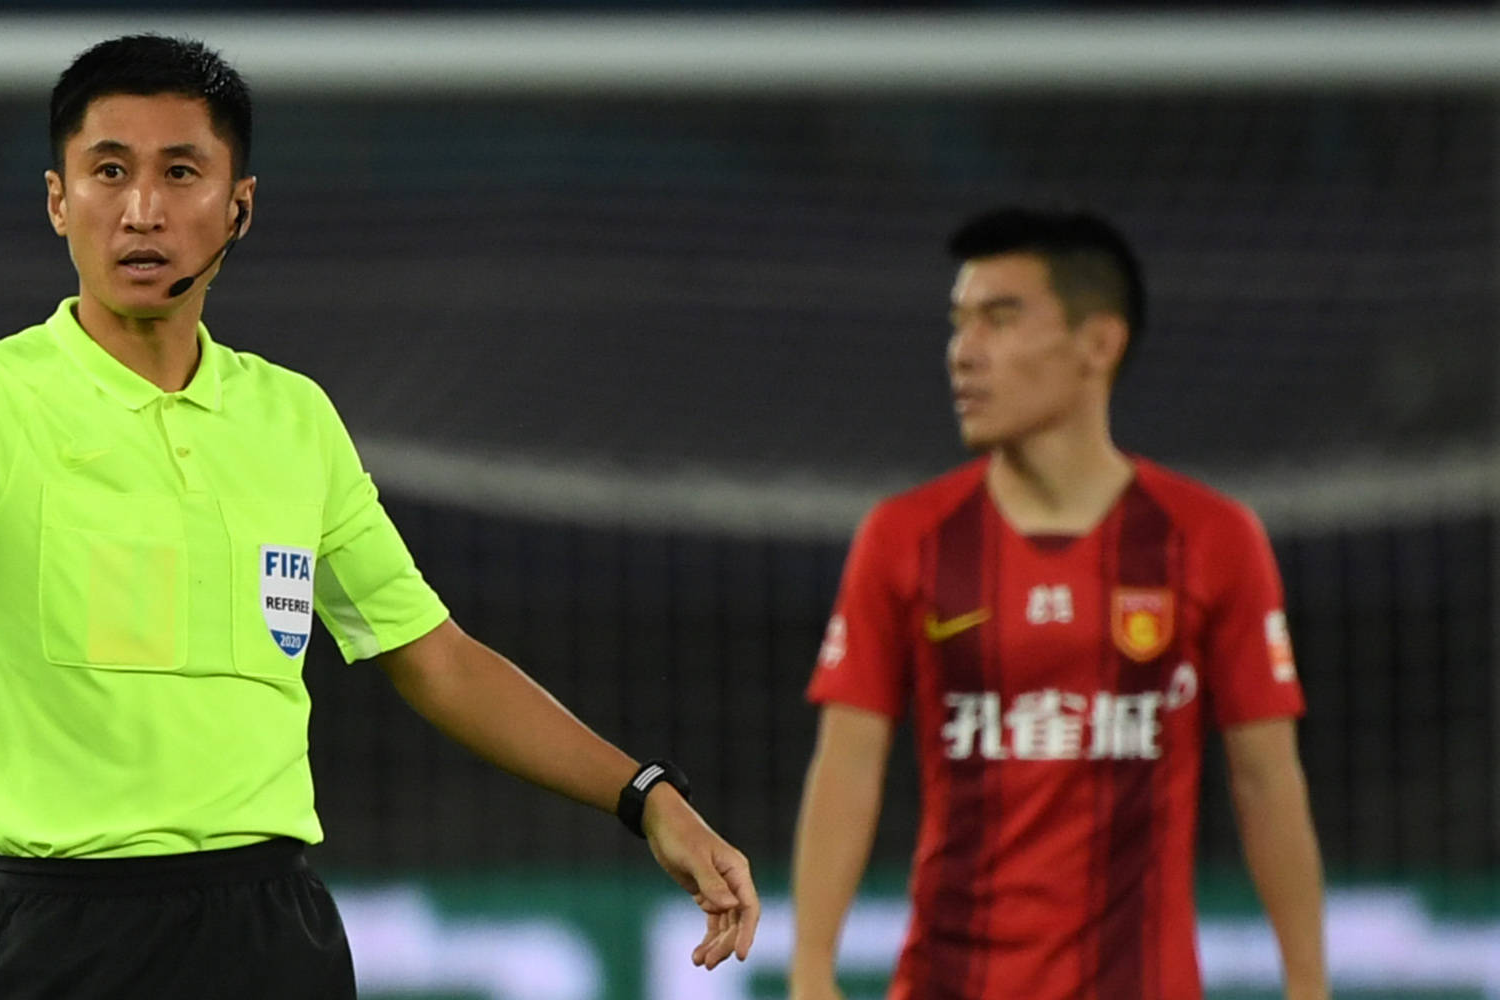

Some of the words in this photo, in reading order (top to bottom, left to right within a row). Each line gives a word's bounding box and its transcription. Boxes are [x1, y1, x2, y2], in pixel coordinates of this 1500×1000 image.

[265, 550, 311, 581] FIFA
[265, 595, 311, 615] REFEREE
[279, 633, 301, 650] 2020
